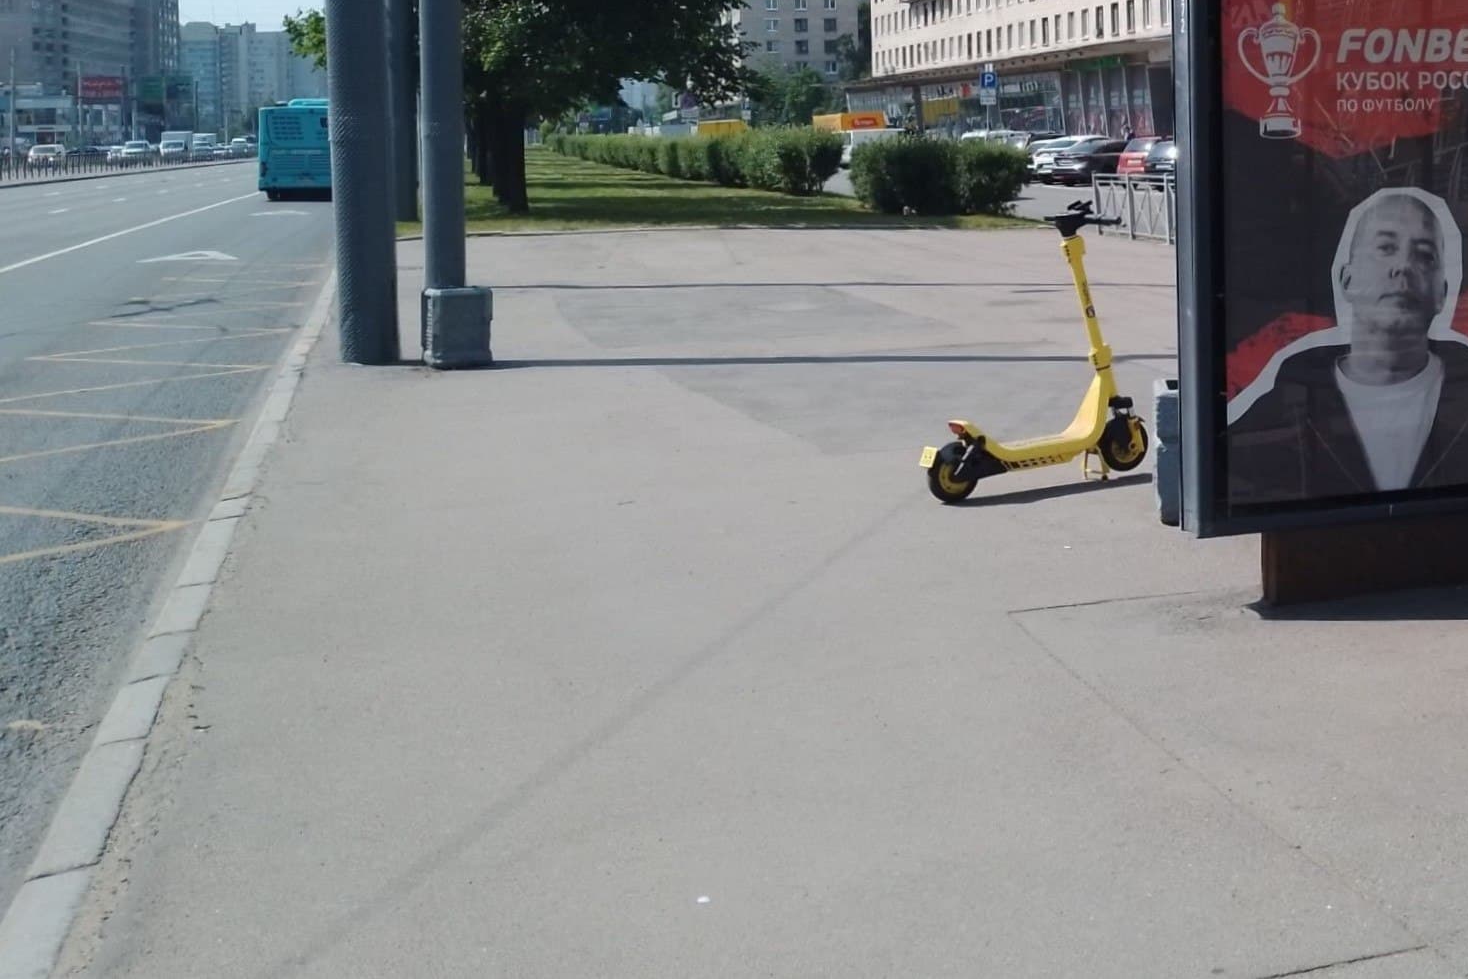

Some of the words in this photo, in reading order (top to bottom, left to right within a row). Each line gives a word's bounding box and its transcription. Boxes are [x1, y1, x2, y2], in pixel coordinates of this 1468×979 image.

[984, 73, 994, 86] P
[1336, 72, 1410, 91] КУБОК
[1336, 99, 1358, 113] ПО
[1362, 98, 1436, 113] ФУТБОЛУ
